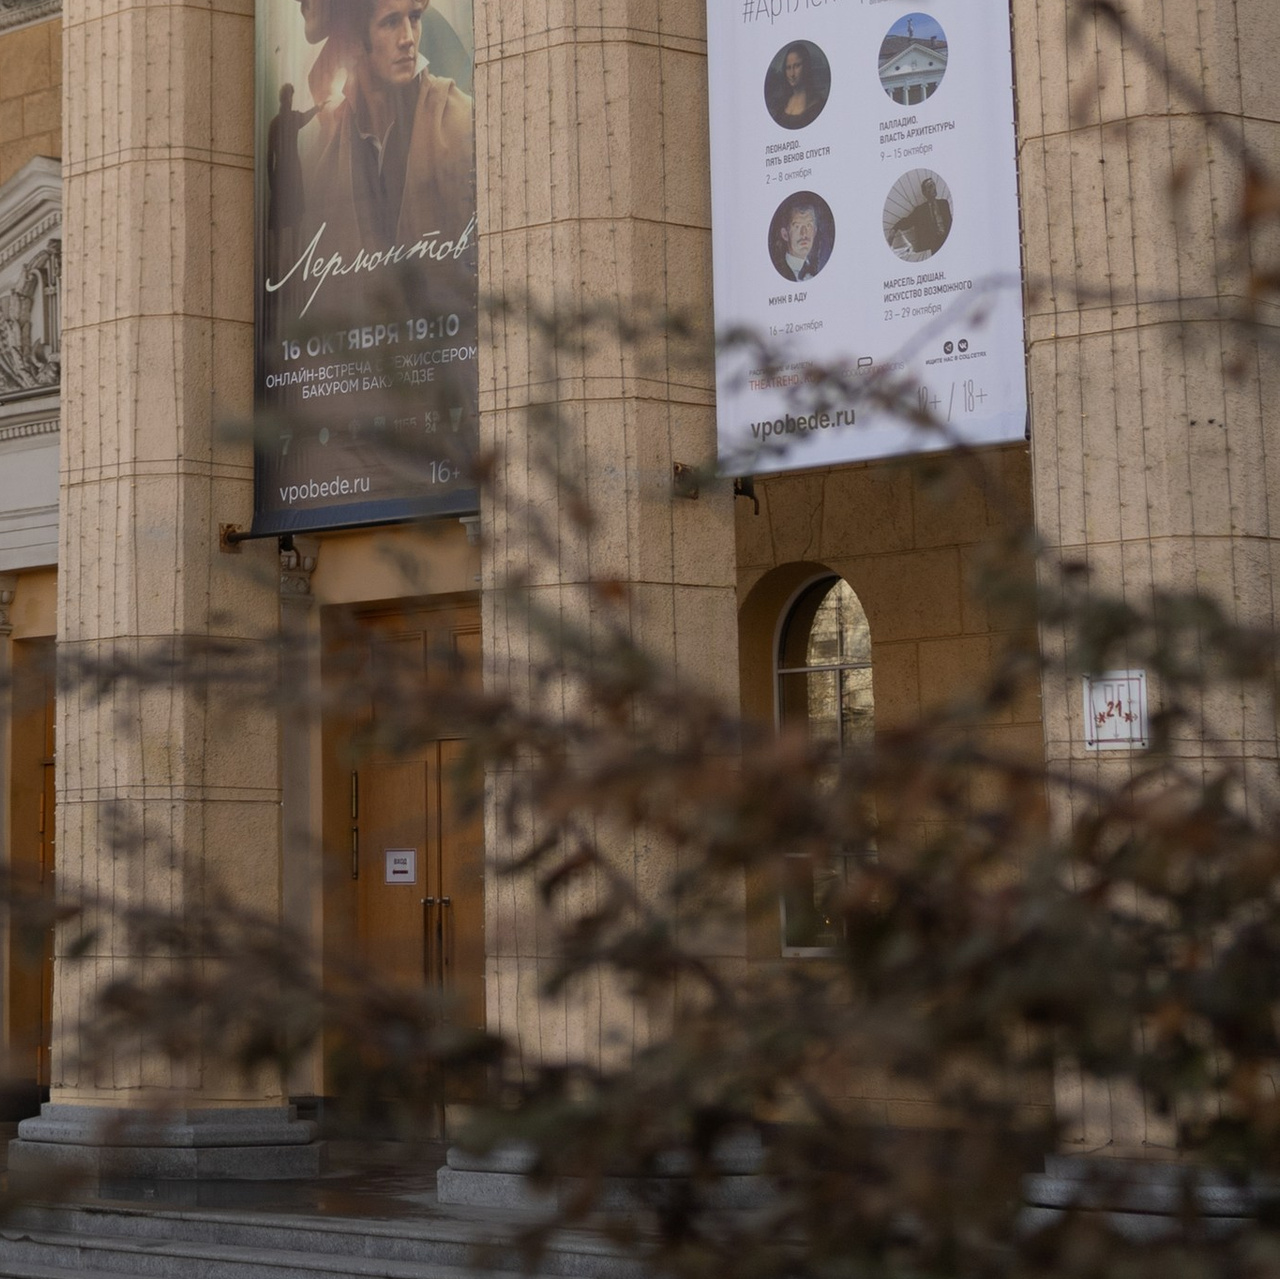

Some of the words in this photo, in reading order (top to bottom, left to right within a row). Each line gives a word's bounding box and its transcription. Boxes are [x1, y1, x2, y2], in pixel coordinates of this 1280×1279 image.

[879, 115, 918, 131] ПАЛЛАДИО.
[879, 131, 905, 145] ВЛАСТЬ
[906, 120, 956, 139] АРХИТЕКТУРЫ
[765, 140, 801, 155] ЛЕОНАРДО.
[765, 157, 782, 168] ПЯТЬ
[783, 151, 804, 164] ВЕКОВ
[805, 146, 831, 159] СПУСТЯ
[880, 151, 885, 161] 9
[894, 147, 902, 159] 15
[903, 143, 933, 158] октября
[766, 174, 771, 184] 2
[778, 171, 783, 182] 8
[784, 167, 812, 181] октября
[883, 276, 915, 290] МАРСЕЛЬ
[916, 271, 947, 285] ДЮШАН.
[883, 288, 922, 303] ИСКУССТВО
[923, 279, 973, 297] ВОЗМОЖНОГО
[768, 294, 787, 306] МУНК
[787, 293, 793, 303] В
[794, 291, 808, 303] АДУ
[884, 309, 893, 321] 23
[901, 306, 911, 318] 29
[911, 303, 942, 317] октября
[281, 339, 301, 361] 16
[306, 323, 399, 357] ОКТЯБРЯ
[405, 313, 460, 342] 19:10
[769, 326, 778, 336] 16
[785, 322, 794, 334] 22
[795, 318, 823, 332] октября
[265, 360, 372, 389] ОНЛАЙН-ВСТРЕЧА
[391, 346, 478, 369] ЕЖИССЕРОМ
[302, 378, 359, 400] БАКУРОМ
[963, 379, 988, 413] 18+
[750, 408, 856, 441] vpobede.ru
[429, 459, 461, 484] 16+
[279, 476, 370, 504] vpobede.ru
[1106, 700, 1123, 718] 21
